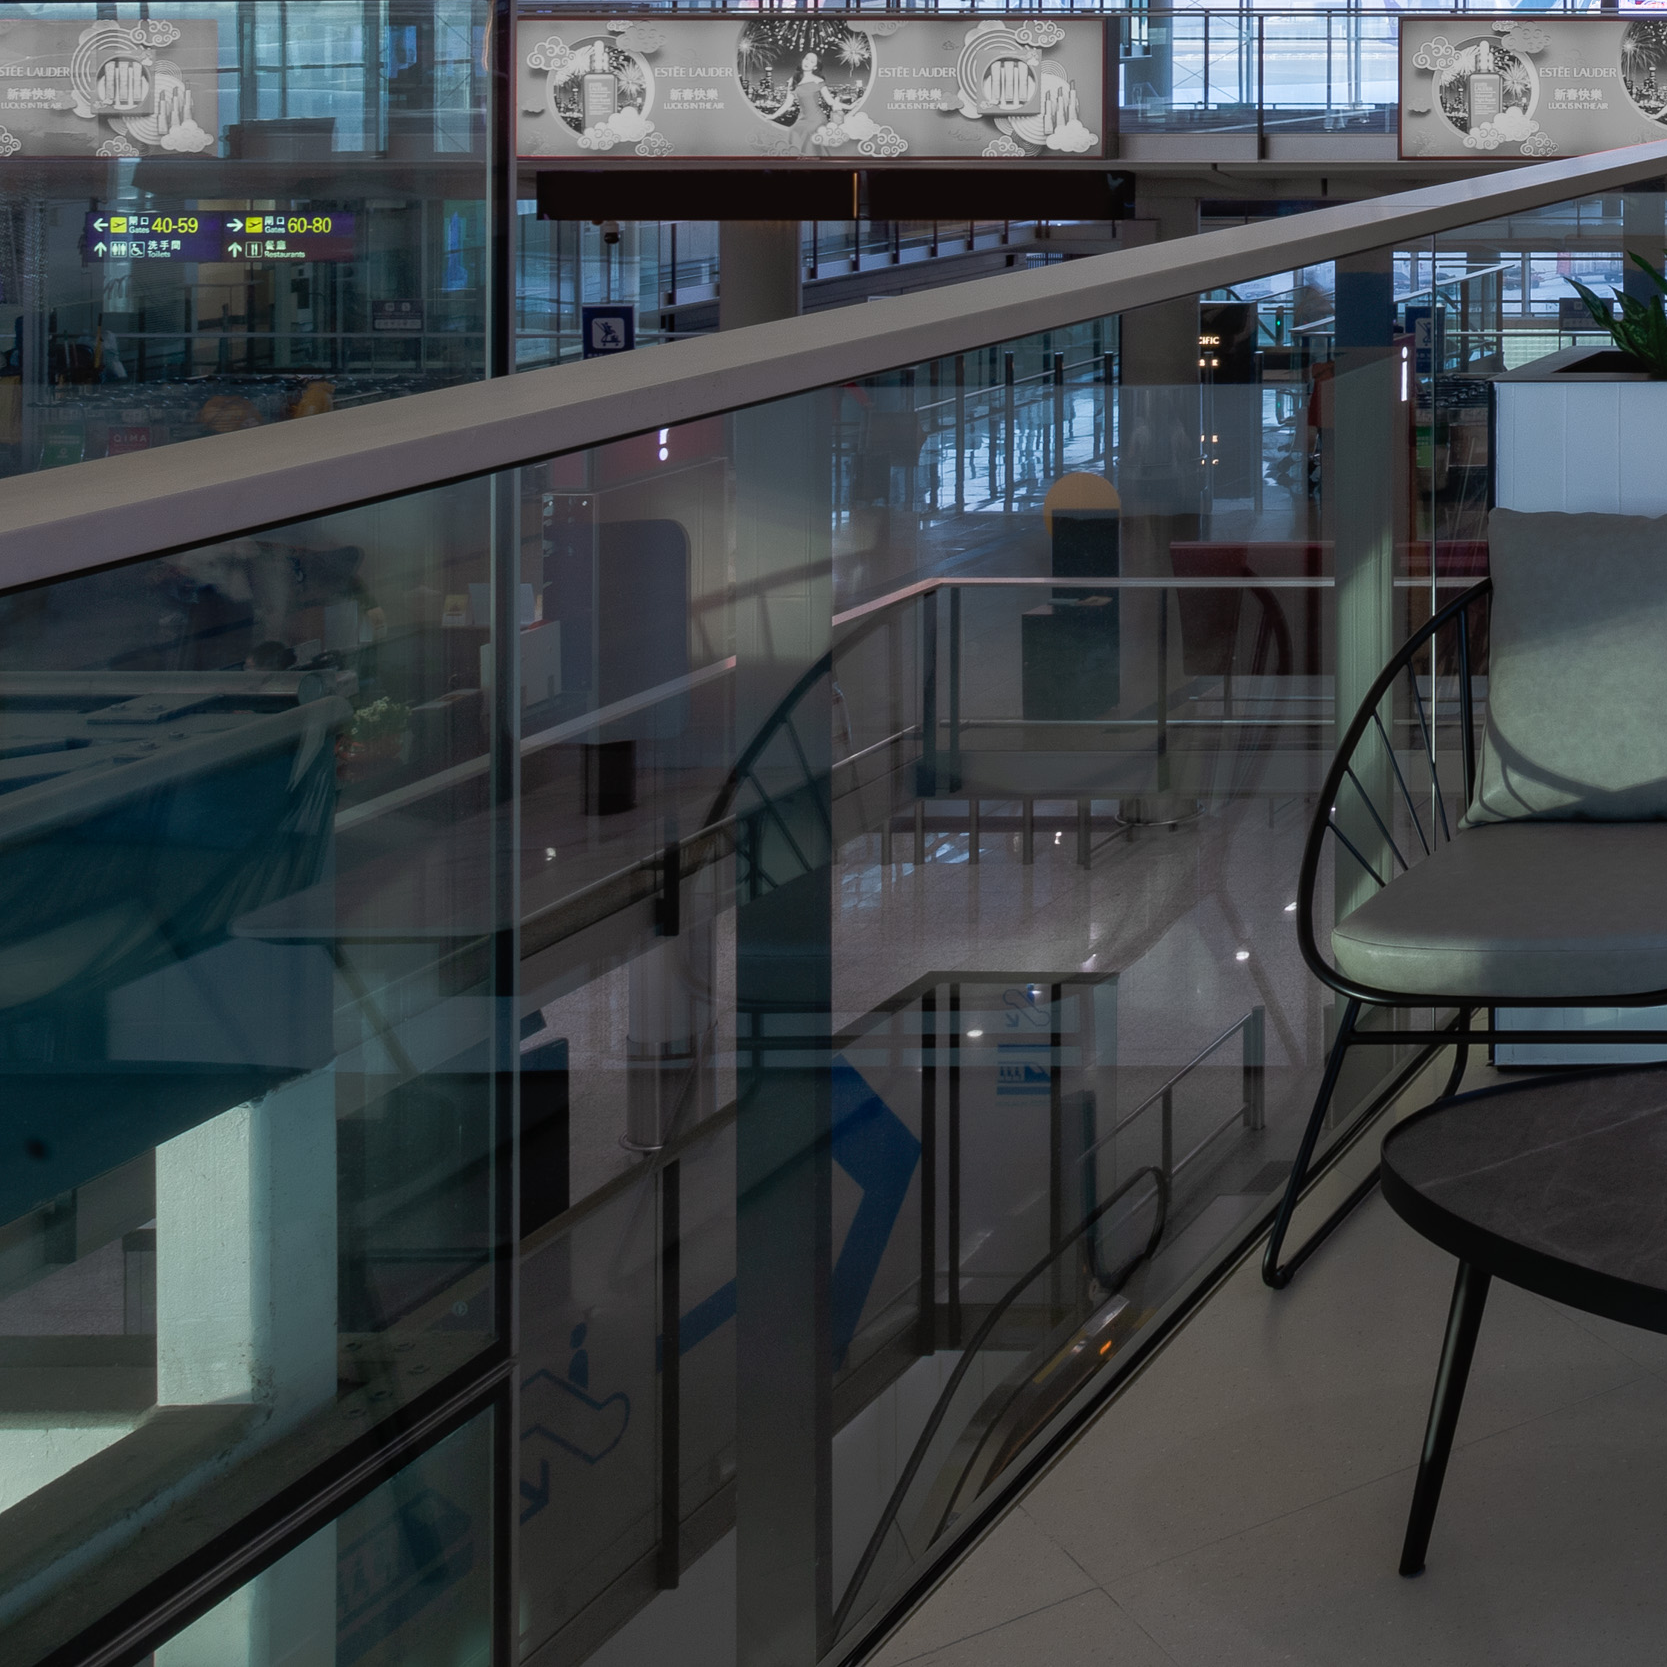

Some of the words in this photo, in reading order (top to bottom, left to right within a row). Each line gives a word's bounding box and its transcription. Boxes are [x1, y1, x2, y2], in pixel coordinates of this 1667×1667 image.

[27, 67, 70, 78] LAUDER
[689, 67, 733, 78] LAUDER
[913, 67, 956, 78] LAUDER
[1574, 67, 1617, 78] LAUDER
[7, 88, 56, 101] 新春快樂
[670, 88, 718, 101] 新春快樂
[893, 88, 942, 101] 新春快樂
[1554, 88, 1602, 101] 新春快樂
[128, 226, 150, 234] Gates
[151, 217, 199, 234] 40-59
[264, 226, 286, 234] Gates
[287, 217, 331, 234] 60-80
[147, 240, 181, 251] 洗手間
